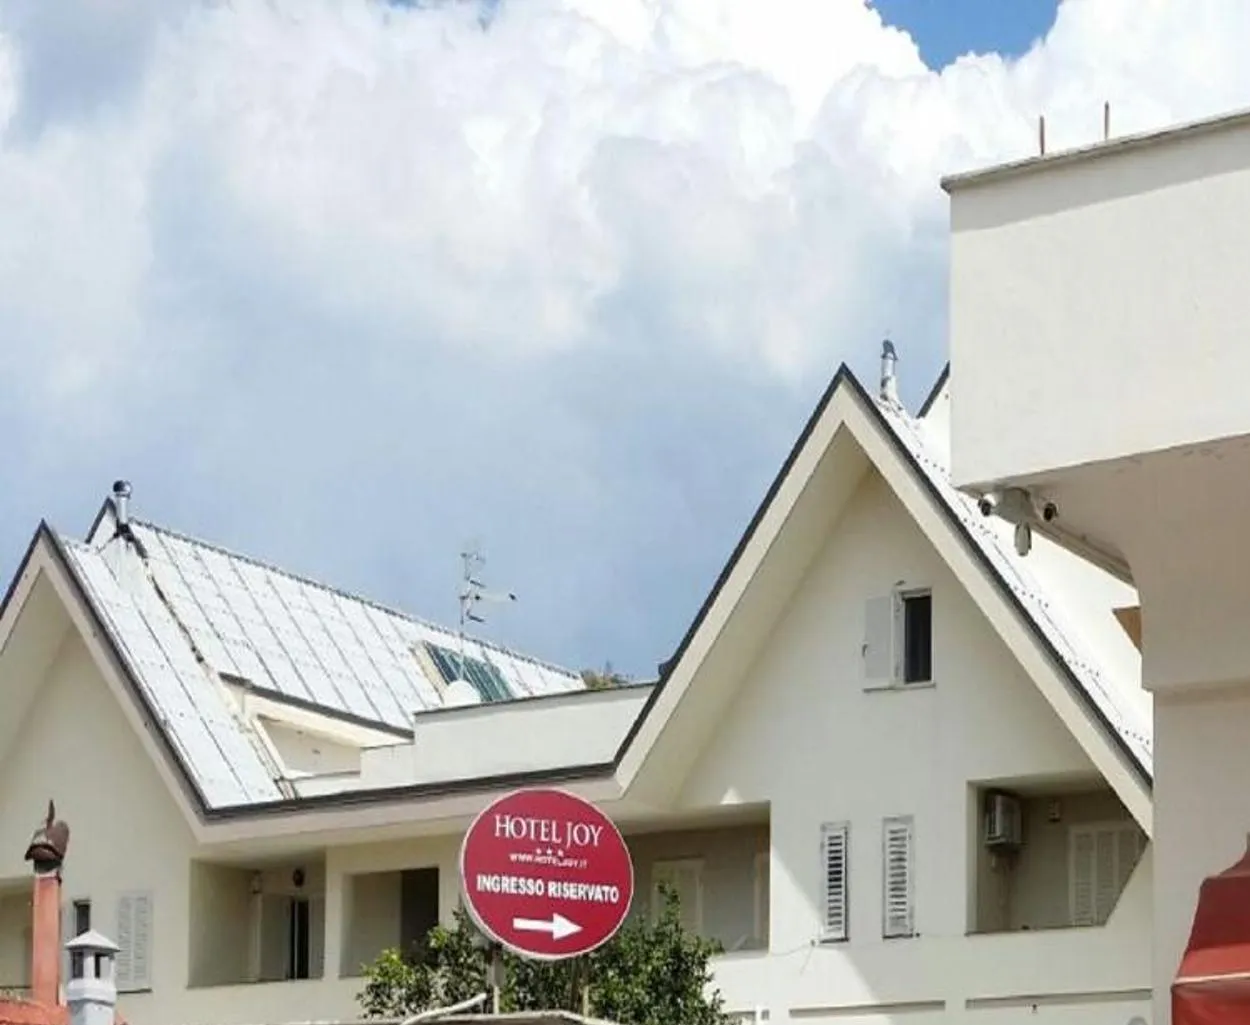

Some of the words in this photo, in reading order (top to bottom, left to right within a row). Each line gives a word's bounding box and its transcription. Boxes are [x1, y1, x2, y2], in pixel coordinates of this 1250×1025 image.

[494, 814, 562, 844] HOTEL
[566, 821, 603, 848] JOY
[476, 874, 545, 896] INGRESSO
[548, 881, 620, 904] RISERVATO
